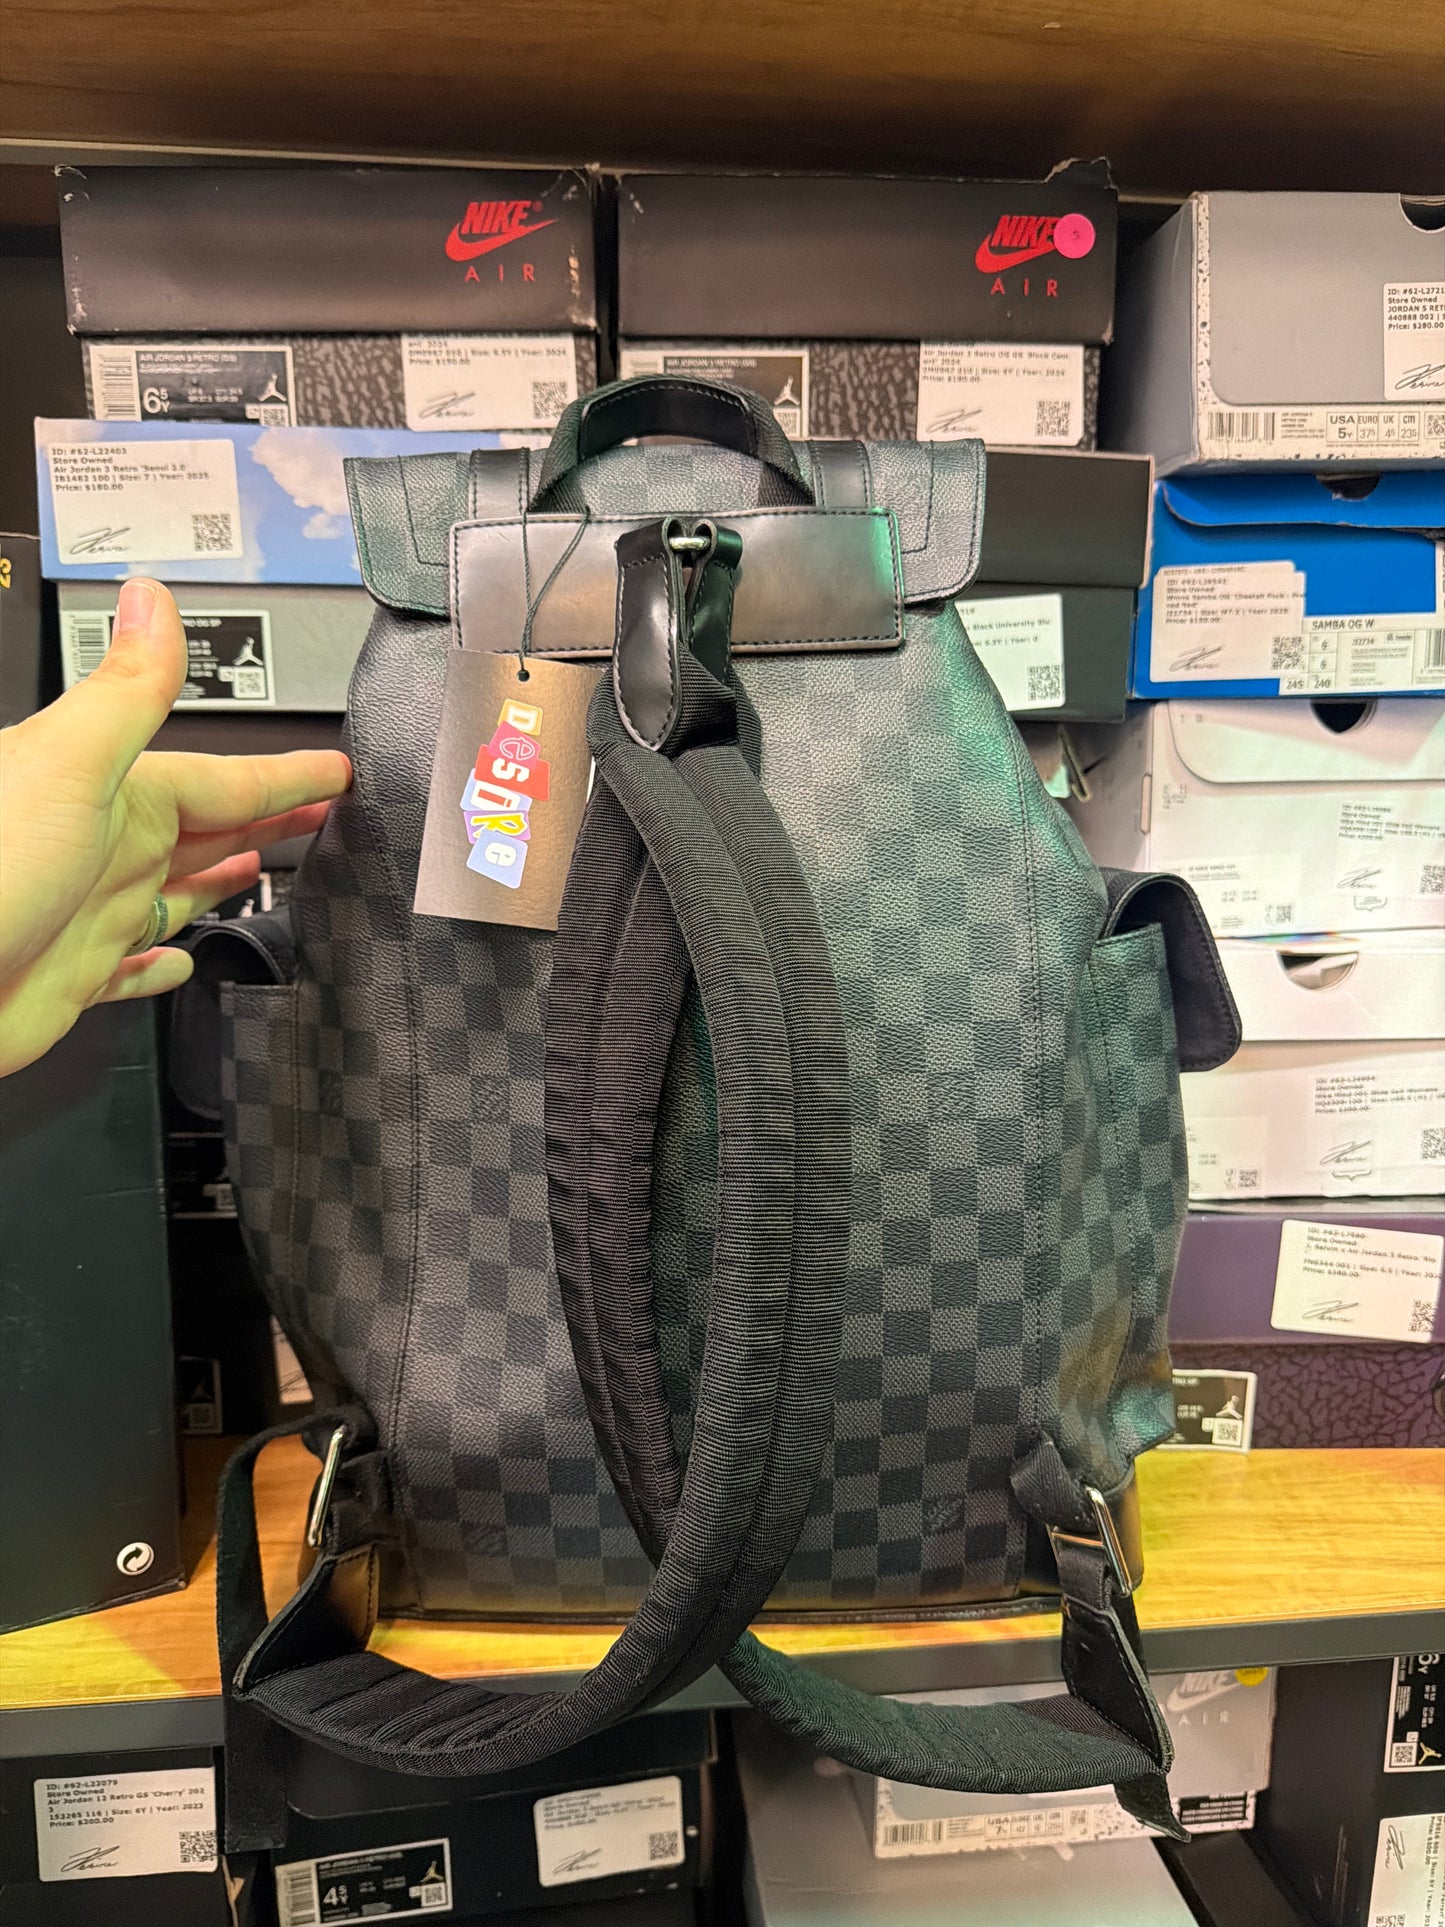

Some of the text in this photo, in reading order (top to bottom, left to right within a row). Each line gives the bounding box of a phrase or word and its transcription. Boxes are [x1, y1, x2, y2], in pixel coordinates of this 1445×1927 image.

[460, 200, 532, 234] NIKE
[464, 263, 536, 282] AIR
[990, 277, 1058, 297] AIR
[1388, 305, 1420, 313] JORDAN
[1330, 416, 1355, 424] USA
[1358, 416, 1378, 424] EURO
[1383, 416, 1394, 424] UK
[53, 457, 78, 465] Store
[1312, 619, 1374, 630] SAMBA OG W
[47, 1783, 61, 1791] ID:
[47, 1788, 105, 1798] Store Owned
[63, 1796, 93, 1804] Jordan
[111, 1808, 133, 1816] Size:
[156, 1804, 178, 1812] Year:
[50, 1820, 75, 1828] Price:
